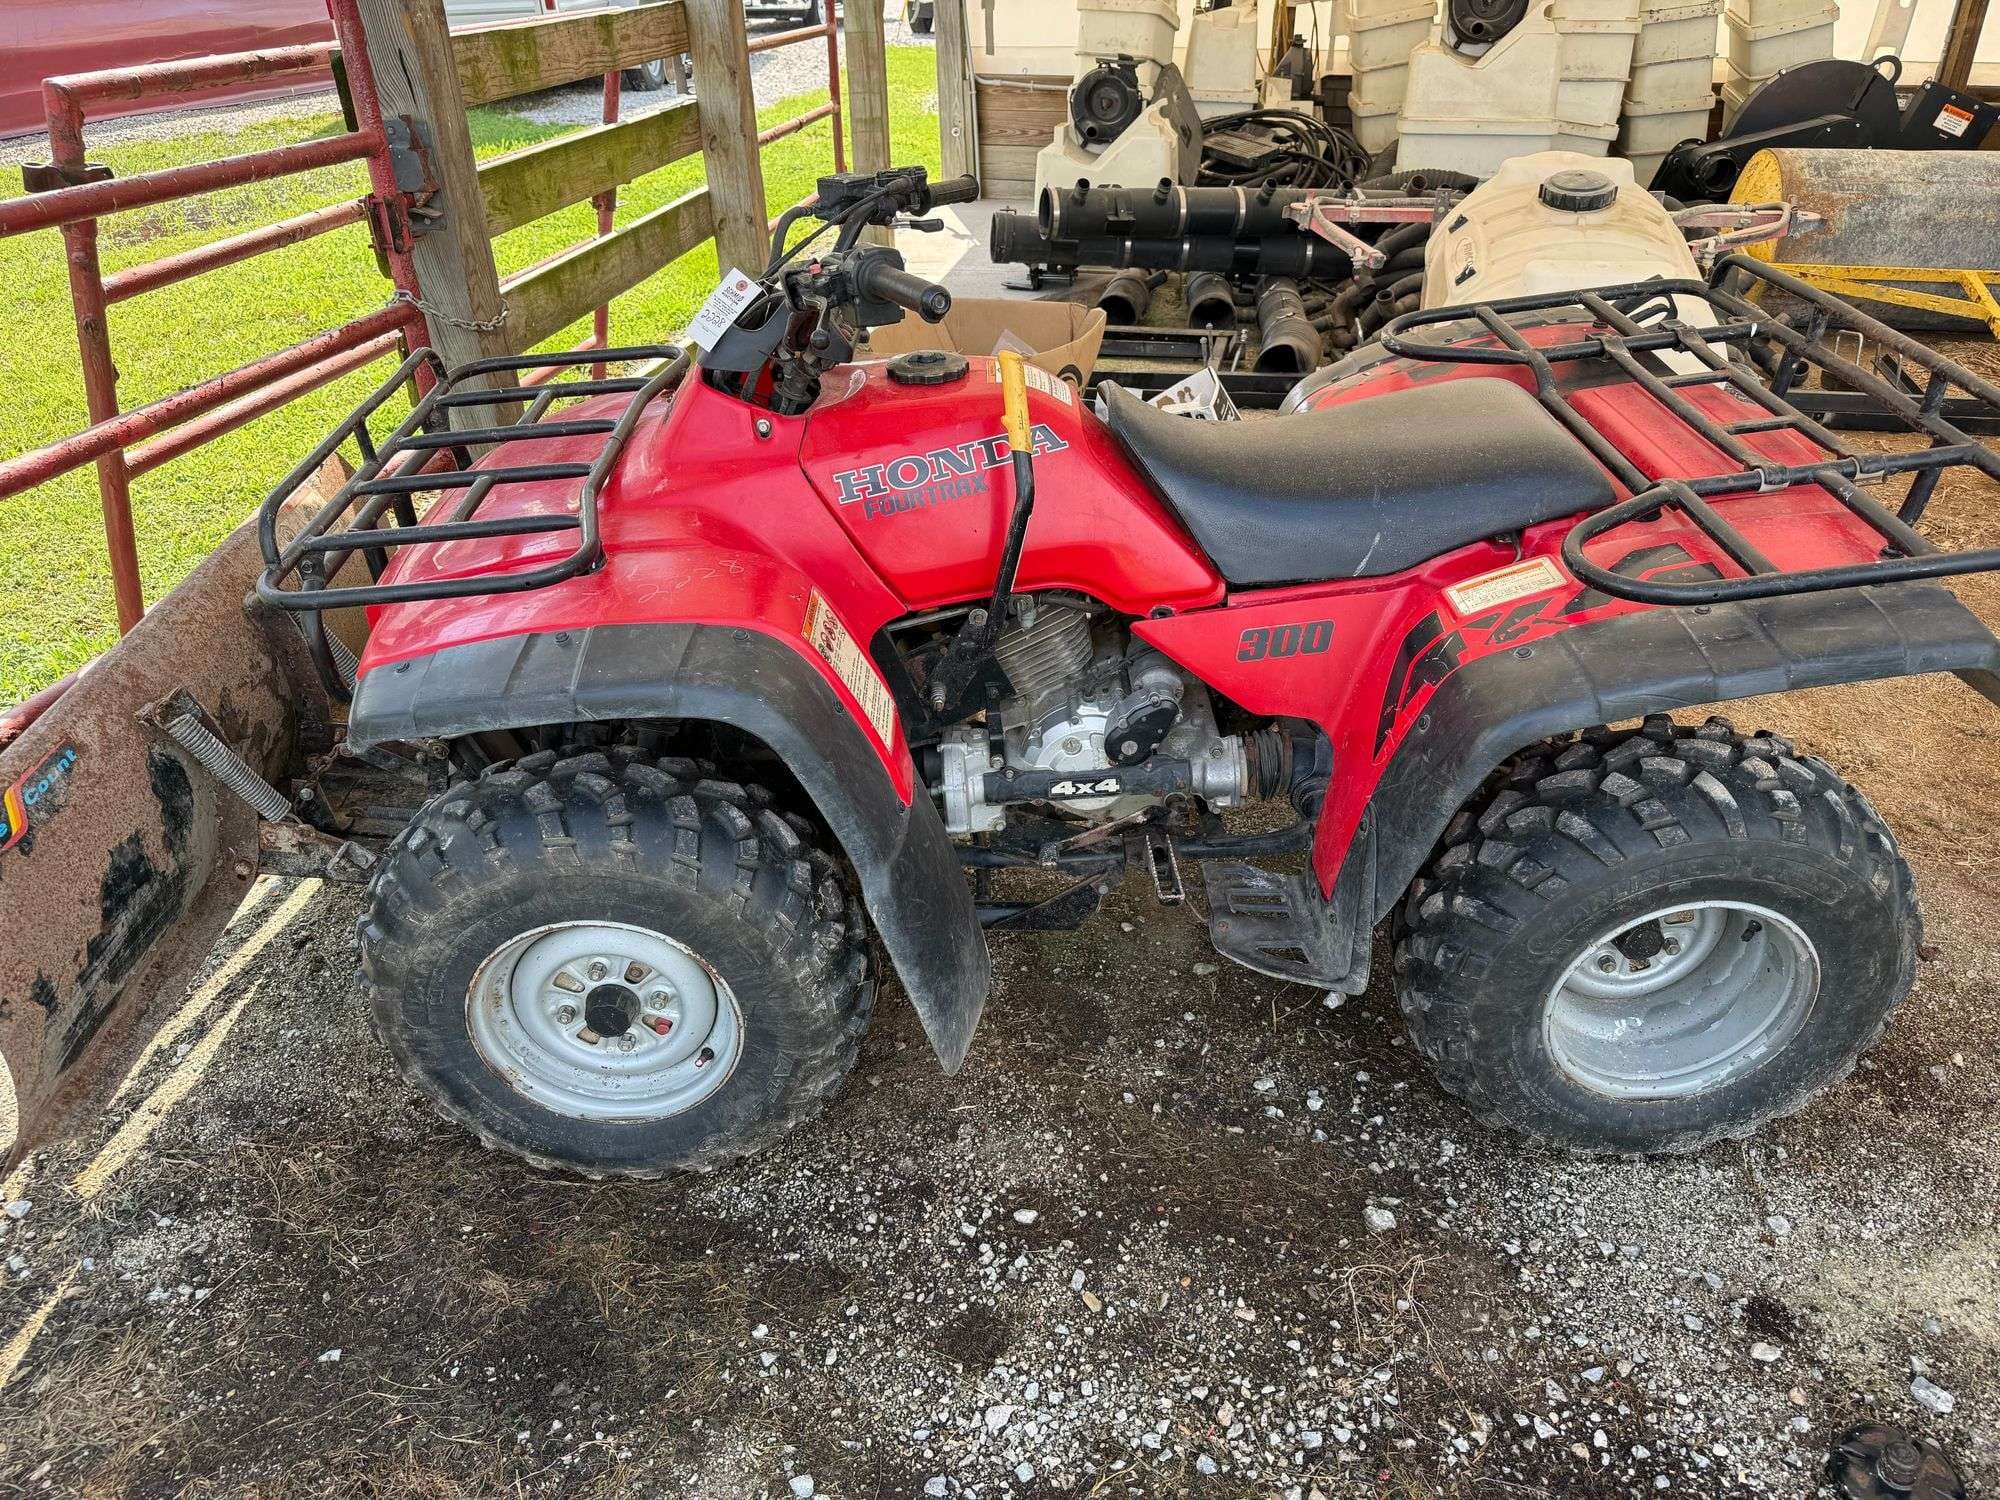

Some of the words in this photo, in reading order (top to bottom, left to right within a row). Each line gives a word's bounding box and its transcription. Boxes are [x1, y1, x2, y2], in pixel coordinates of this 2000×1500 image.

[701, 309, 726, 328] 2228
[833, 423, 1070, 505] HONDA
[863, 473, 990, 521] FOURTRAX
[1236, 618, 1335, 663] 300
[1050, 778, 1121, 796] 4x4
